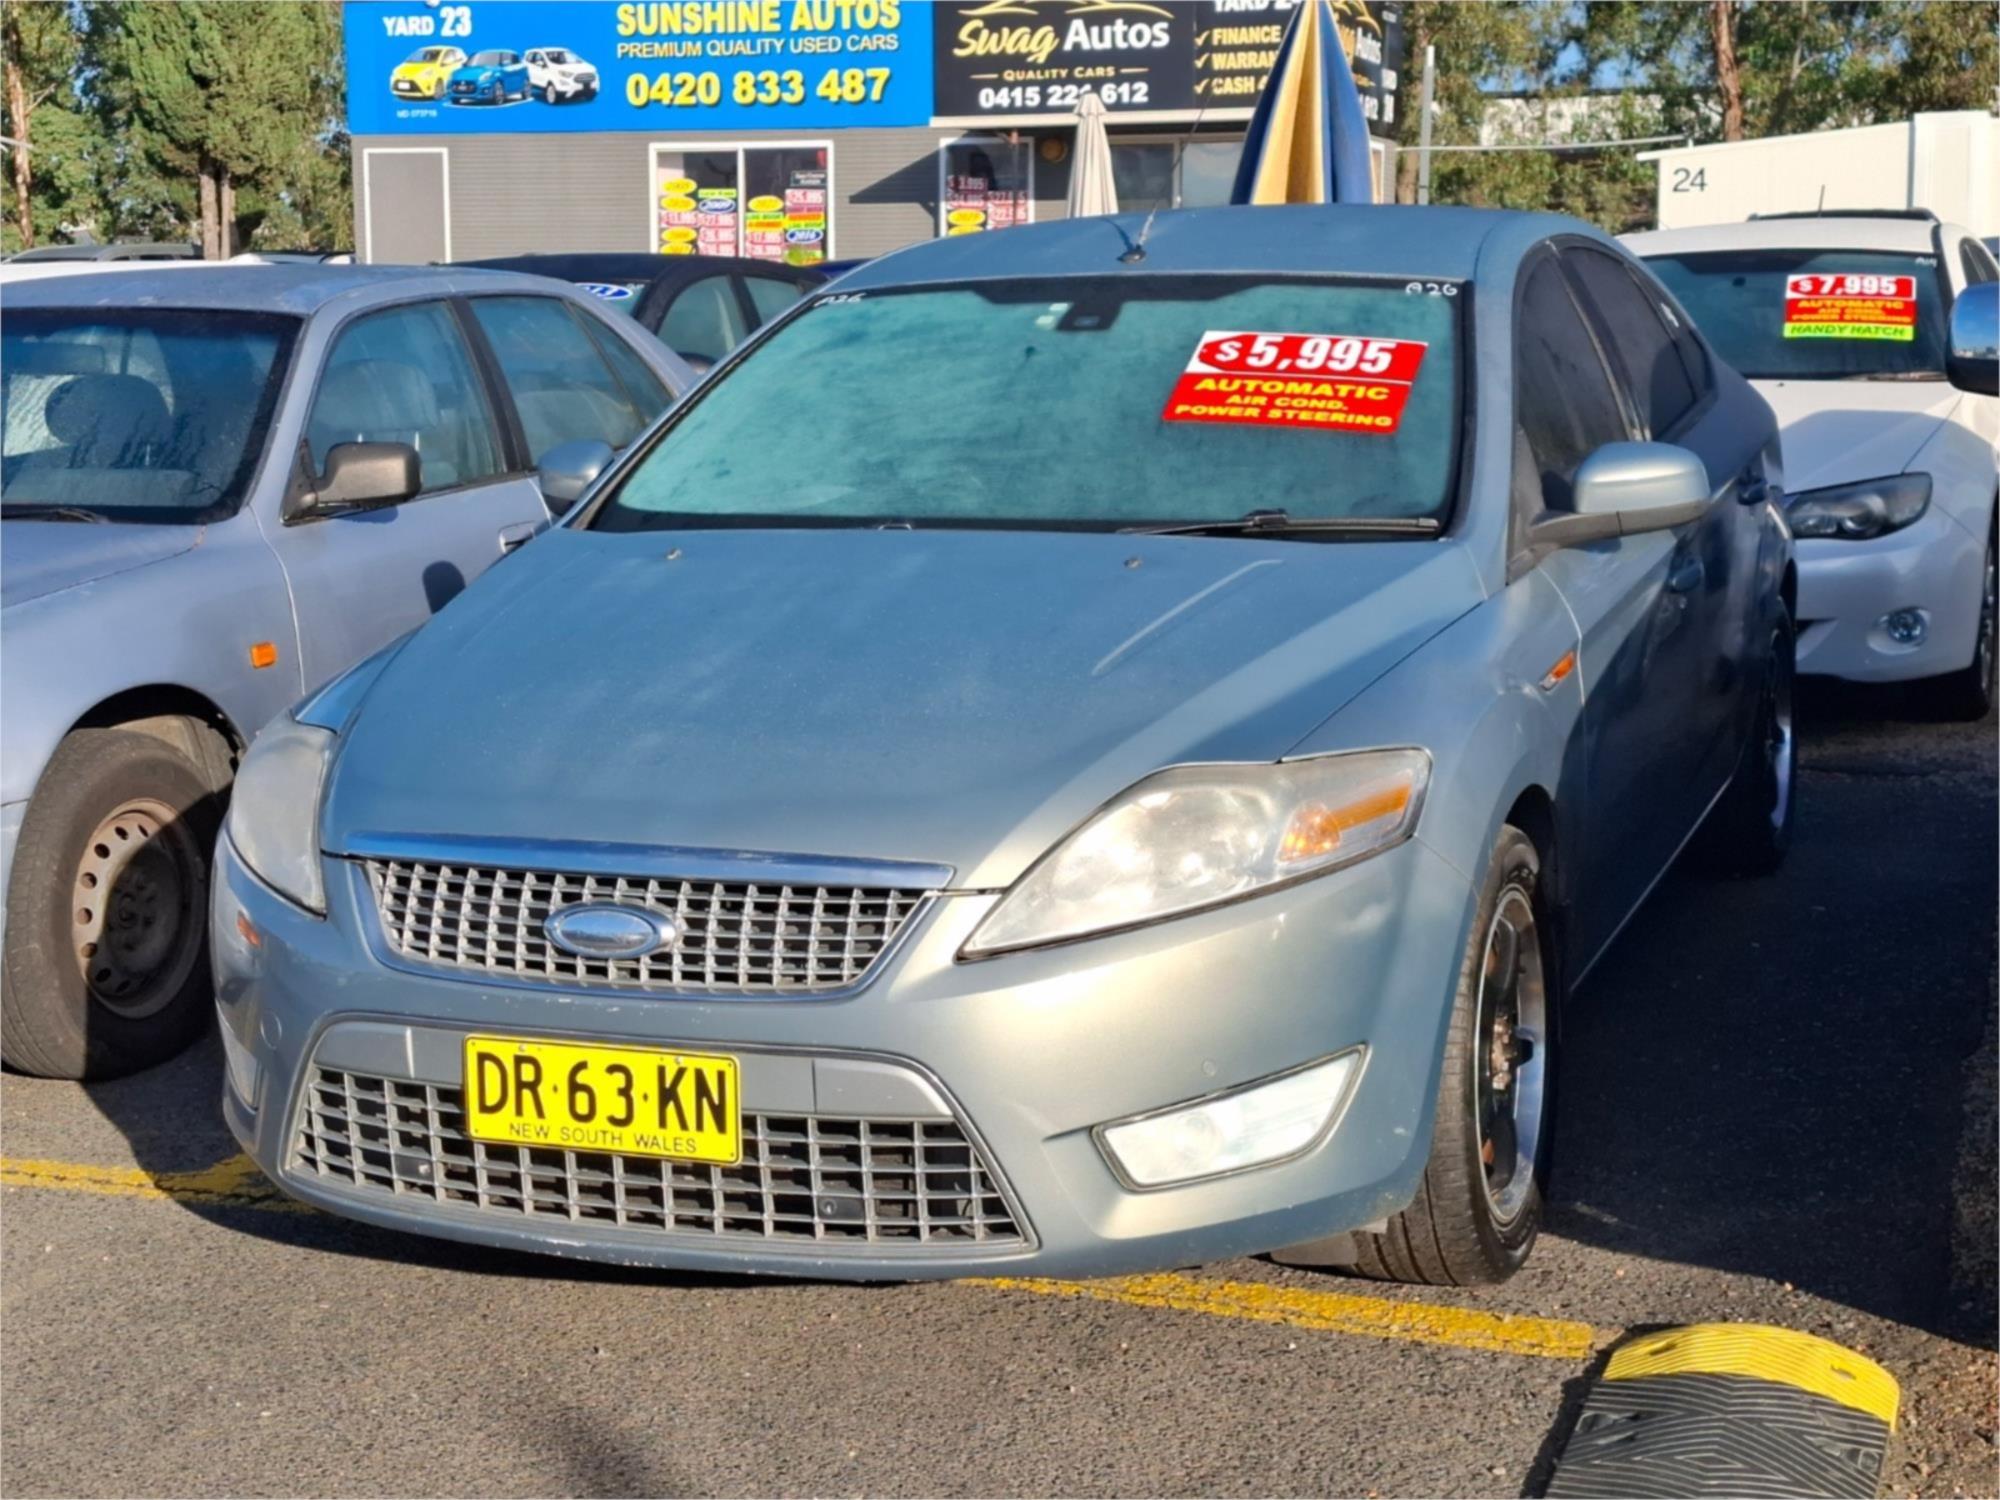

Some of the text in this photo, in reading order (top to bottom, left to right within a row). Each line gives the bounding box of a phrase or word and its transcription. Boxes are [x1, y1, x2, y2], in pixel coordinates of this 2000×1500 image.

[382, 6, 473, 37] YARD 23
[616, 0, 901, 36] SUNSHINE AUTOS
[617, 33, 899, 59] PREMIUM QUALITY USED CARS
[952, 18, 1171, 64] Swag Autos
[1211, 25, 1282, 46] FINANCE
[1211, 50, 1278, 70] WARRAN
[1003, 66, 1116, 81] QUALITY CARS
[626, 67, 891, 107] 0420 833 487
[978, 86, 1042, 109] 0415
[1100, 81, 1149, 105] 612
[1211, 76, 1256, 95] CASH
[1672, 167, 1708, 192] 24
[1797, 299, 1905, 309] AUTOMATIC
[1790, 324, 1907, 336] HANDY HATCH
[1194, 378, 1390, 400] AUTOMATIC
[1225, 394, 1349, 411] AIR COND.
[1174, 404, 1393, 427] POWER STEERING
[509, 1122, 698, 1153] NEW SOUTH WALES
